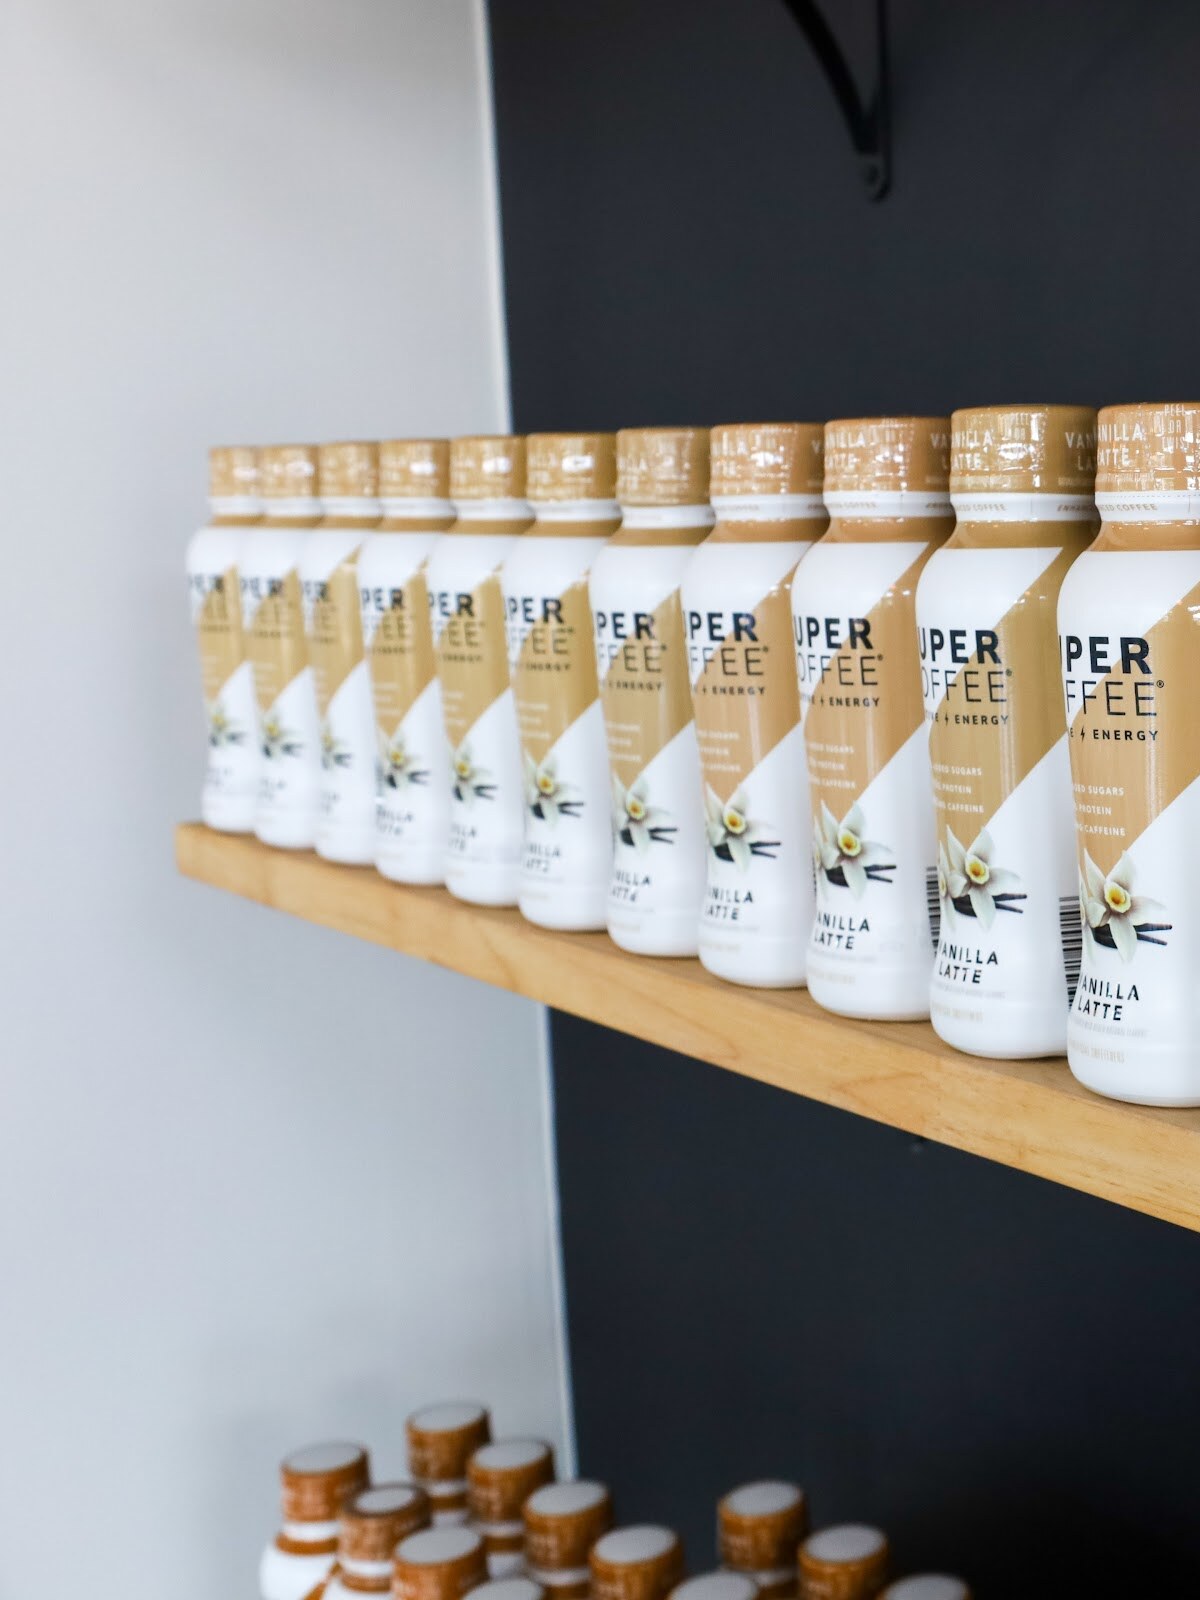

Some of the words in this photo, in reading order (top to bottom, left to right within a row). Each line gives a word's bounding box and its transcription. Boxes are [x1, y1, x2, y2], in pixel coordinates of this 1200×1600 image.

[1098, 448, 1130, 466] ATTE
[508, 598, 564, 624] PER
[597, 612, 655, 639] PER
[689, 611, 759, 641] PER
[794, 616, 873, 649] UPER
[918, 627, 1002, 664] UPER
[1059, 635, 1152, 674] PER
[829, 697, 880, 707] ENERGY
[954, 714, 1009, 725] ENERGY
[1093, 729, 1158, 741] ENERGY
[1088, 785, 1124, 796] SUGARS
[1079, 804, 1112, 815] PROTEIN
[1085, 825, 1126, 836] CAFFEINE
[1081, 973, 1140, 1001] ANILLA
[1078, 995, 1123, 1021] LATTE
